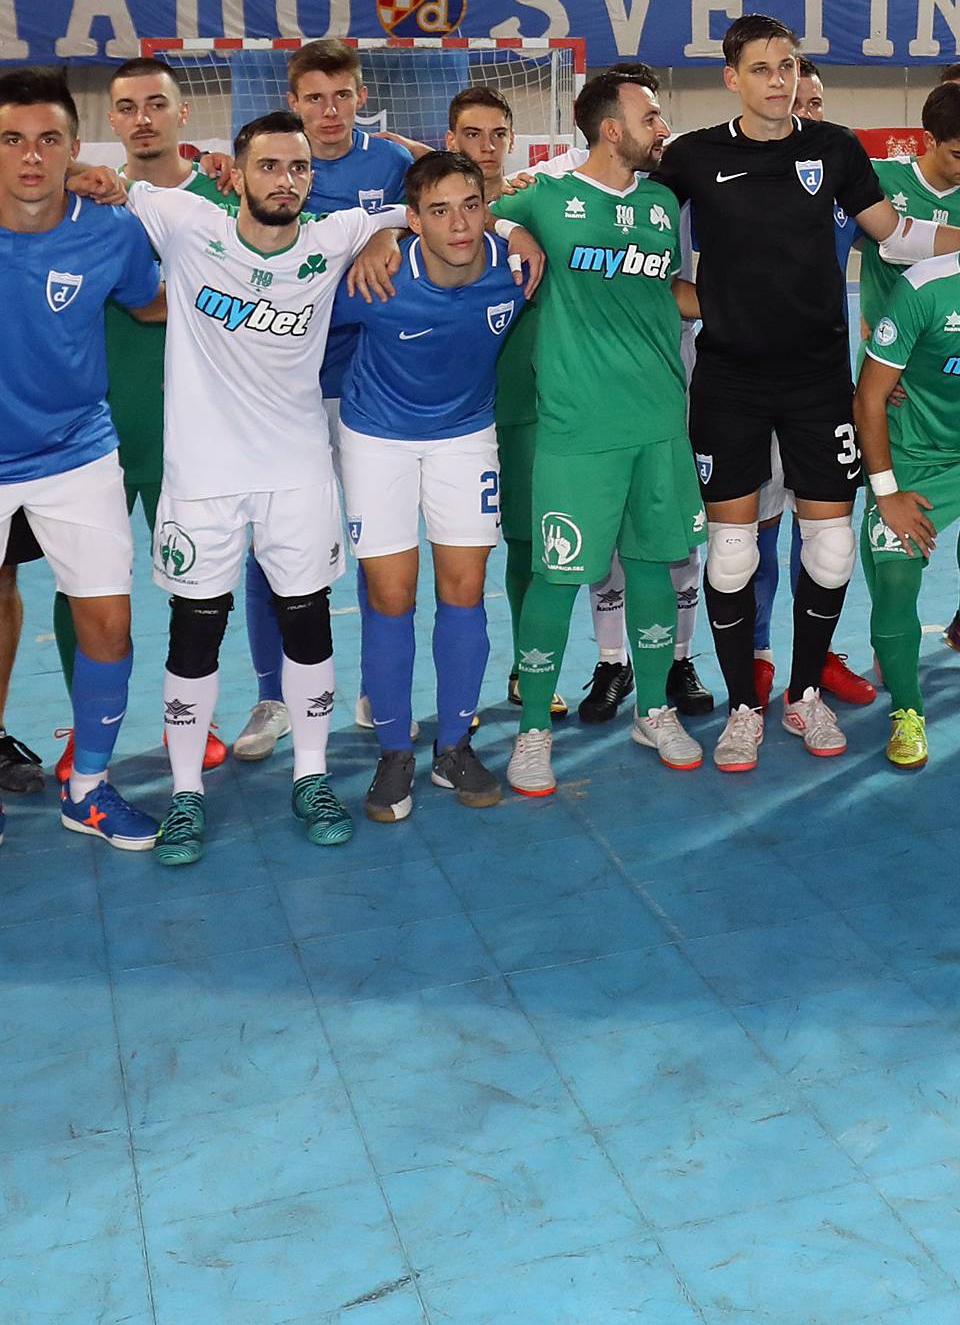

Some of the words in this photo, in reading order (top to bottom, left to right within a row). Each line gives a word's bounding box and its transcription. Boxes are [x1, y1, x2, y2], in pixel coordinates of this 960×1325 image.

[568, 242, 672, 281] mybet
[195, 285, 314, 337] mybet
[834, 422, 861, 465] 3
